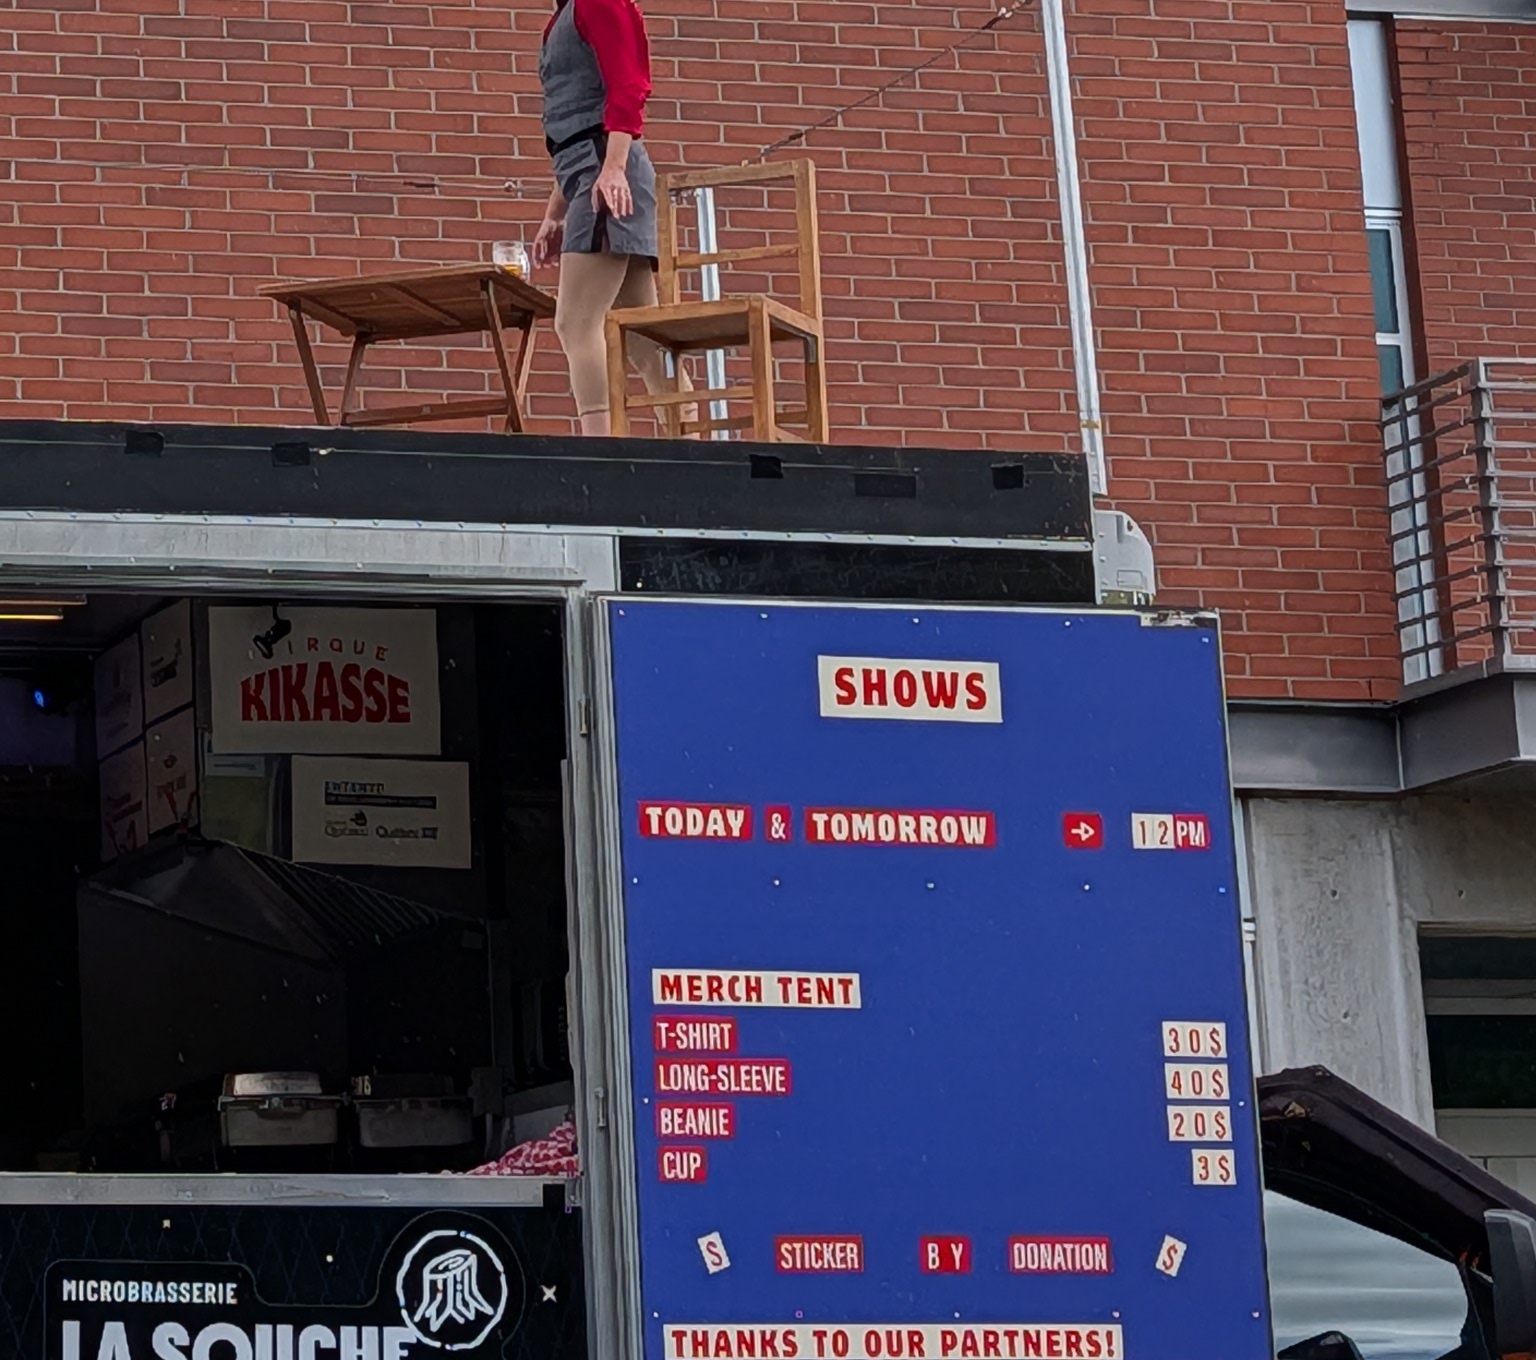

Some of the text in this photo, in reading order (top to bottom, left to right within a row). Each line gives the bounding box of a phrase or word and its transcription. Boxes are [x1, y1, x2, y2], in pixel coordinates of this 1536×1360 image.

[287, 637, 389, 661] IRQUE
[240, 661, 411, 723] KIKASSE
[834, 667, 987, 711] SHOWS
[645, 807, 745, 838] TODAY
[770, 812, 786, 840] &
[812, 812, 987, 845] TOMORROW
[660, 974, 854, 1005] MERCH TENT
[656, 1021, 1222, 1057] T-SHIRT 30$
[658, 1063, 1224, 1098] LONG-SLEEVE 40$
[660, 1108, 1227, 1140] BEANIE 20$
[663, 1151, 1231, 1183] CUP 3$
[780, 1242, 860, 1270] STICKER
[1013, 1243, 1108, 1271] DONATION
[62, 1278, 238, 1305] MICROBRASSERIE
[671, 1329, 1115, 1359] THANKS TO OUR PARTNERS!
